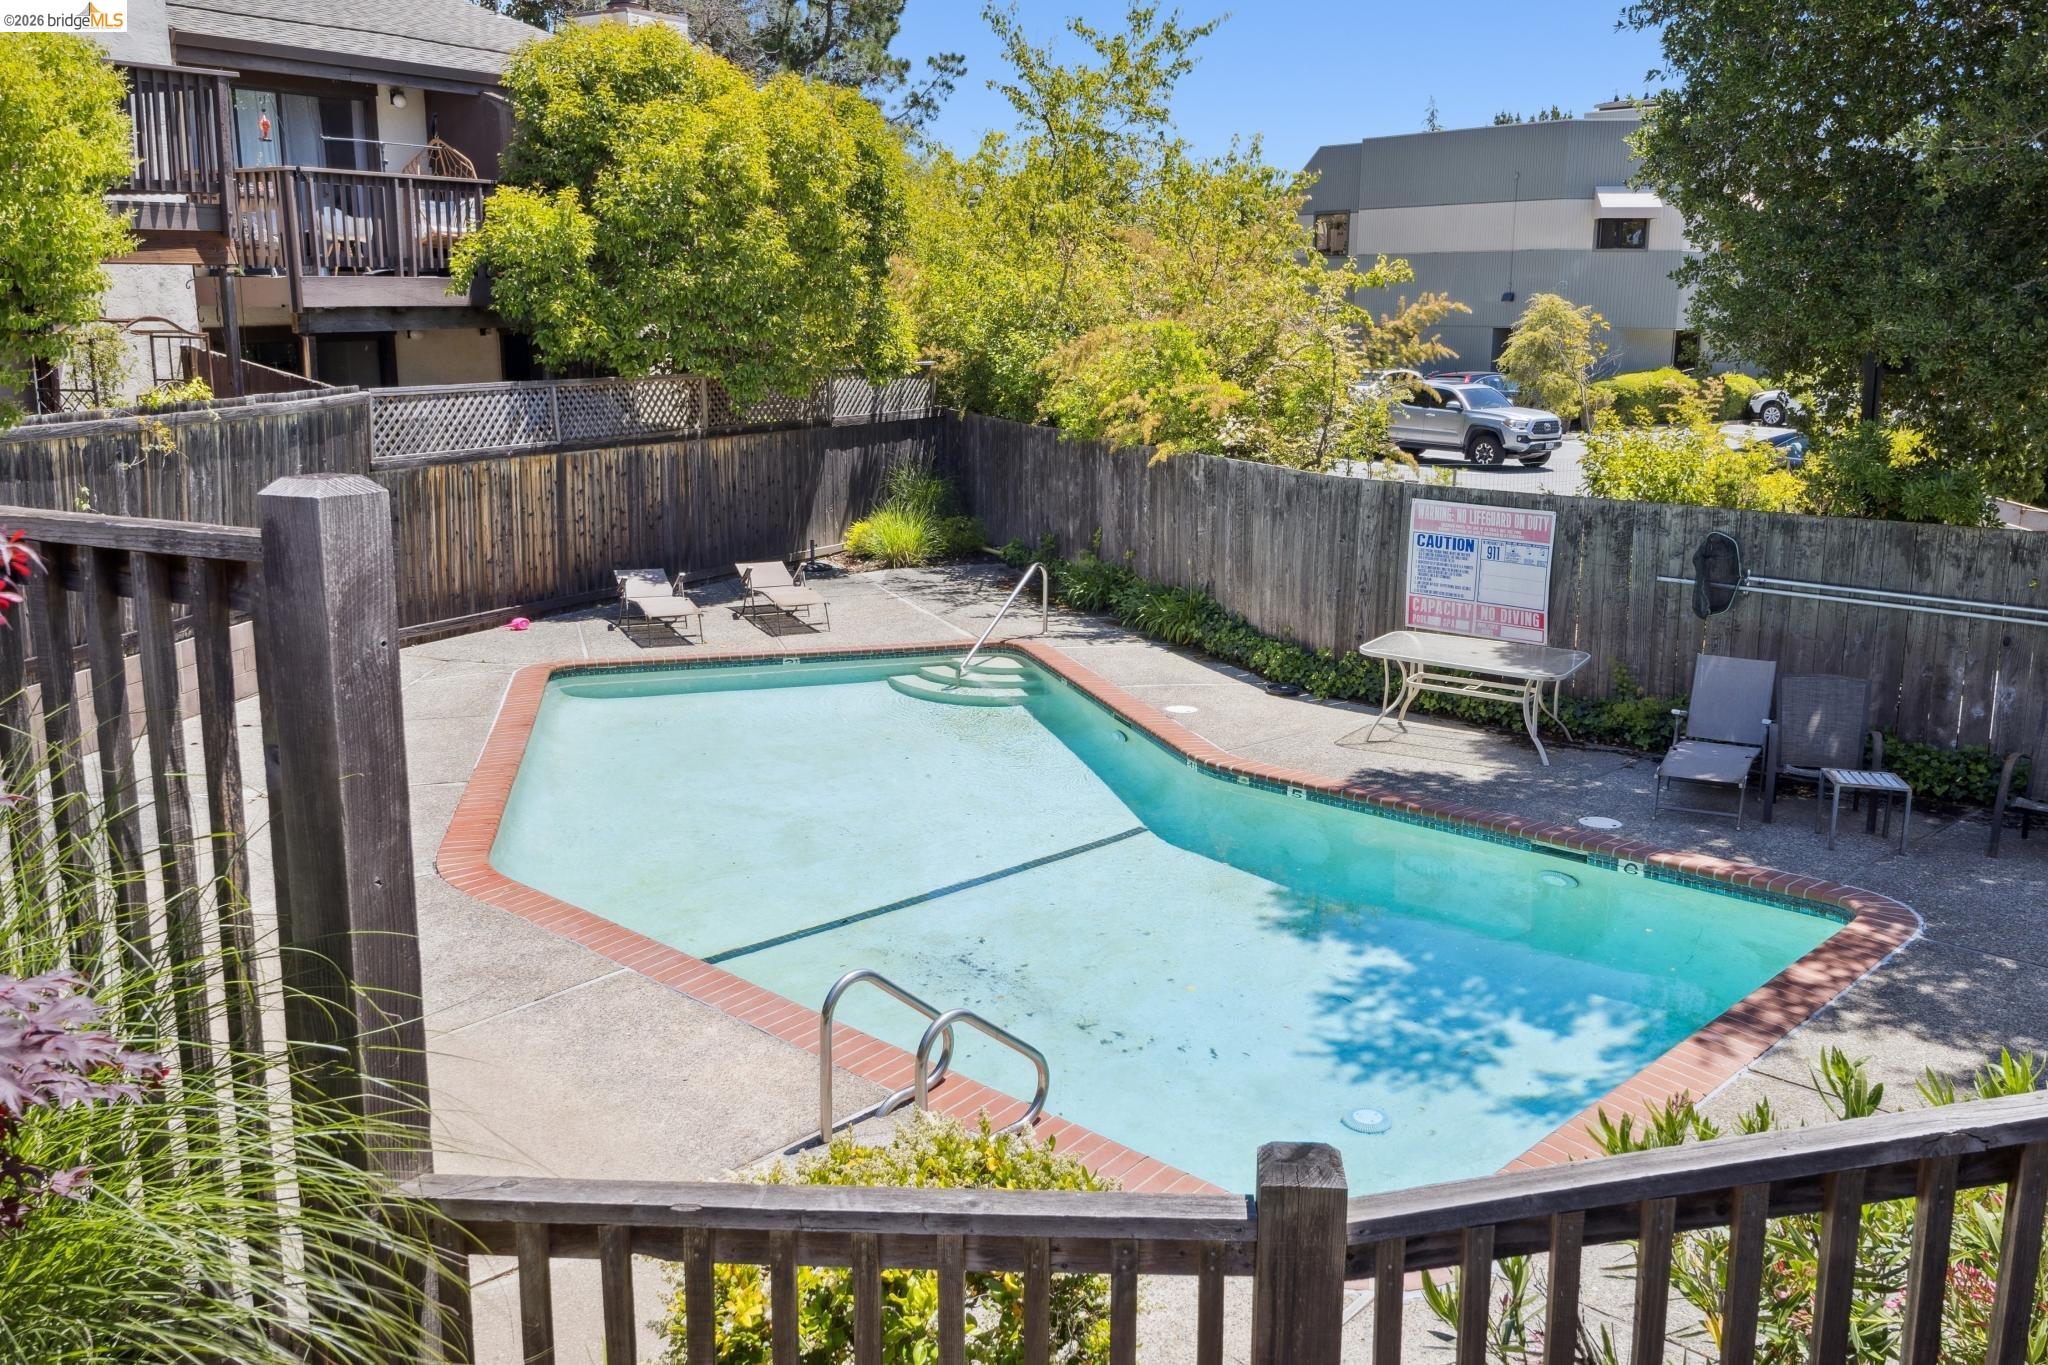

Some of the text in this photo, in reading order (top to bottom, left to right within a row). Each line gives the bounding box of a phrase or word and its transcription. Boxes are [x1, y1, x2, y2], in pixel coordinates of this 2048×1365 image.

[1418, 504, 1455, 522] WARNING:
[1456, 507, 1467, 524] NO
[1469, 508, 1512, 528] LIFEGUARD
[1514, 514, 1525, 530] ON
[1527, 515, 1549, 531] DUTY
[1417, 534, 1475, 552] CAUTION
[1487, 546, 1500, 560] 911
[1412, 597, 1473, 619] CAPACITY
[1480, 606, 1540, 628] NO DIVING
[1442, 618, 1455, 629] SPA
